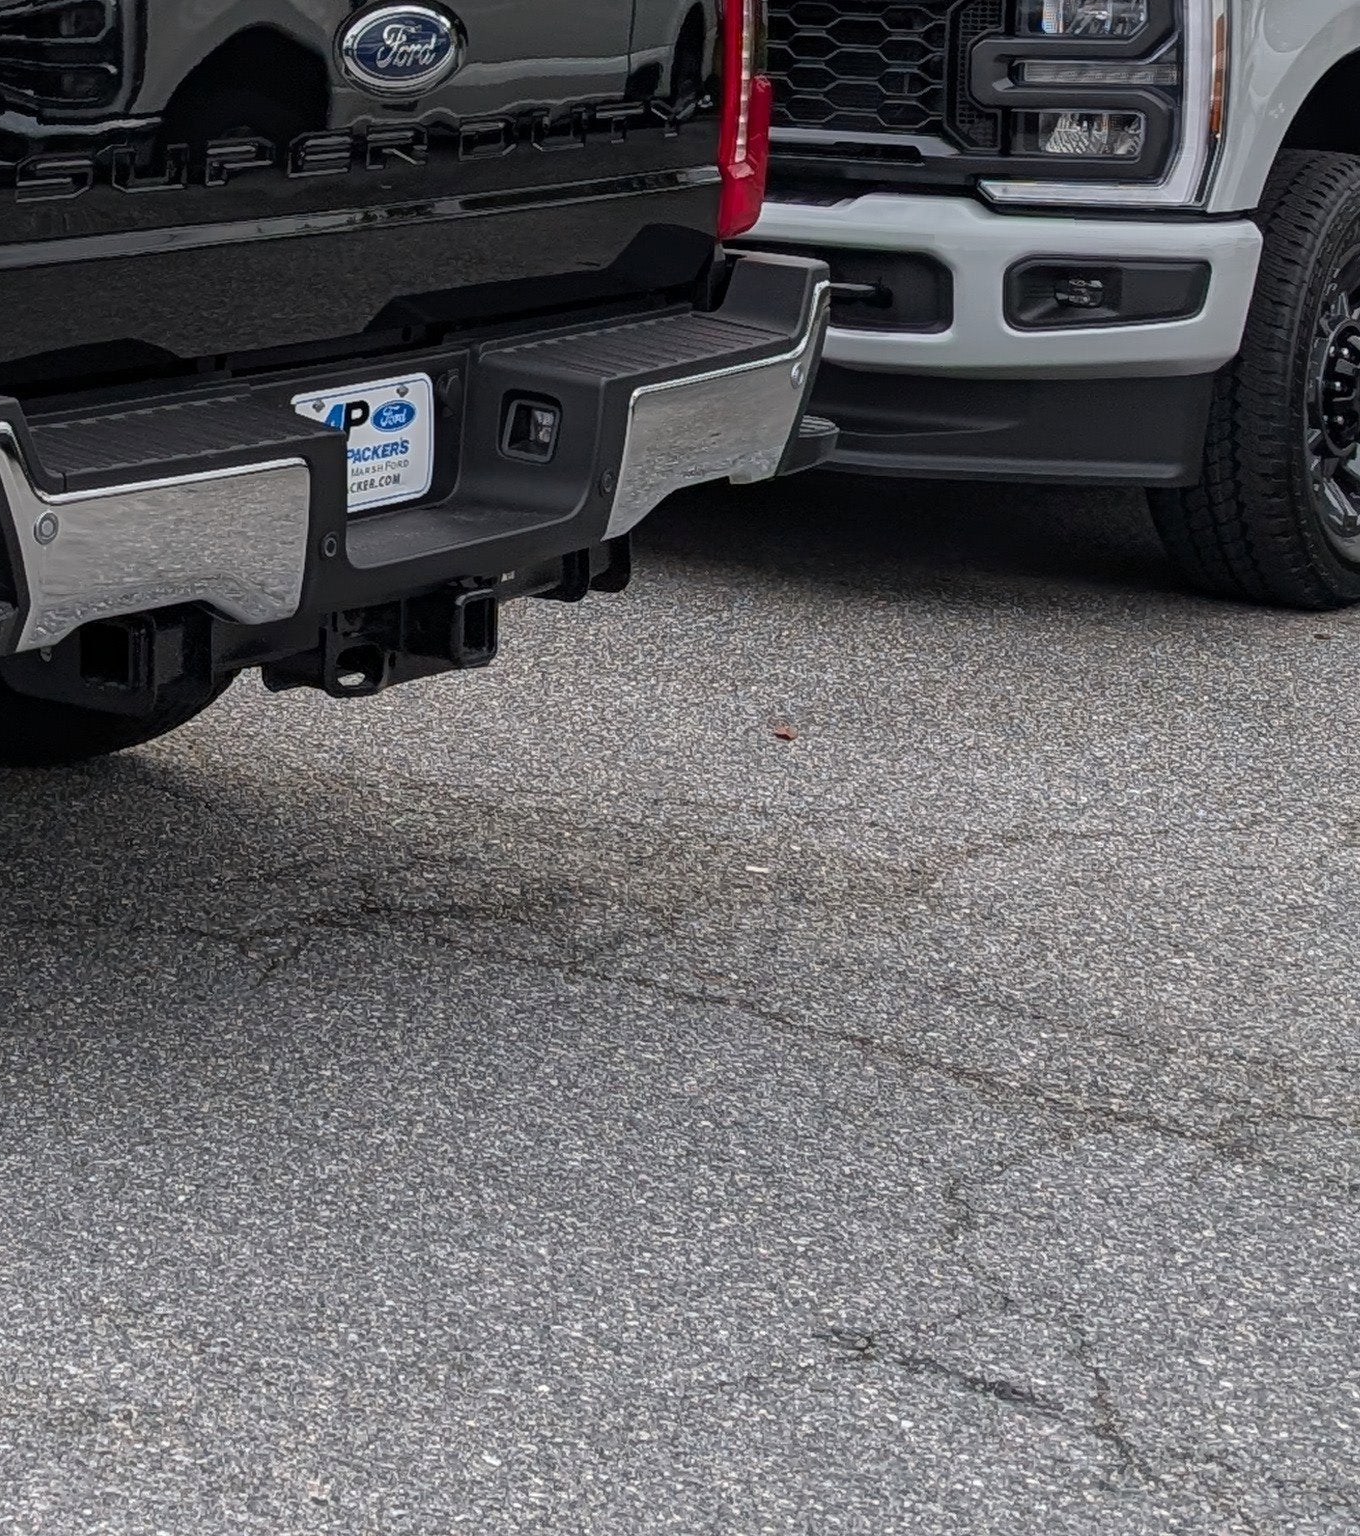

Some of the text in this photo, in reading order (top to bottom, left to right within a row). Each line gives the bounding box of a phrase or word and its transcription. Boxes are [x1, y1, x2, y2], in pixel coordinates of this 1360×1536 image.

[376, 23, 437, 68] Ford
[15, 94, 713, 203] SUPER DUTY
[380, 405, 408, 427] Ford
[351, 459, 410, 477] MARSH FORD
[348, 473, 401, 494] CKER.COM
